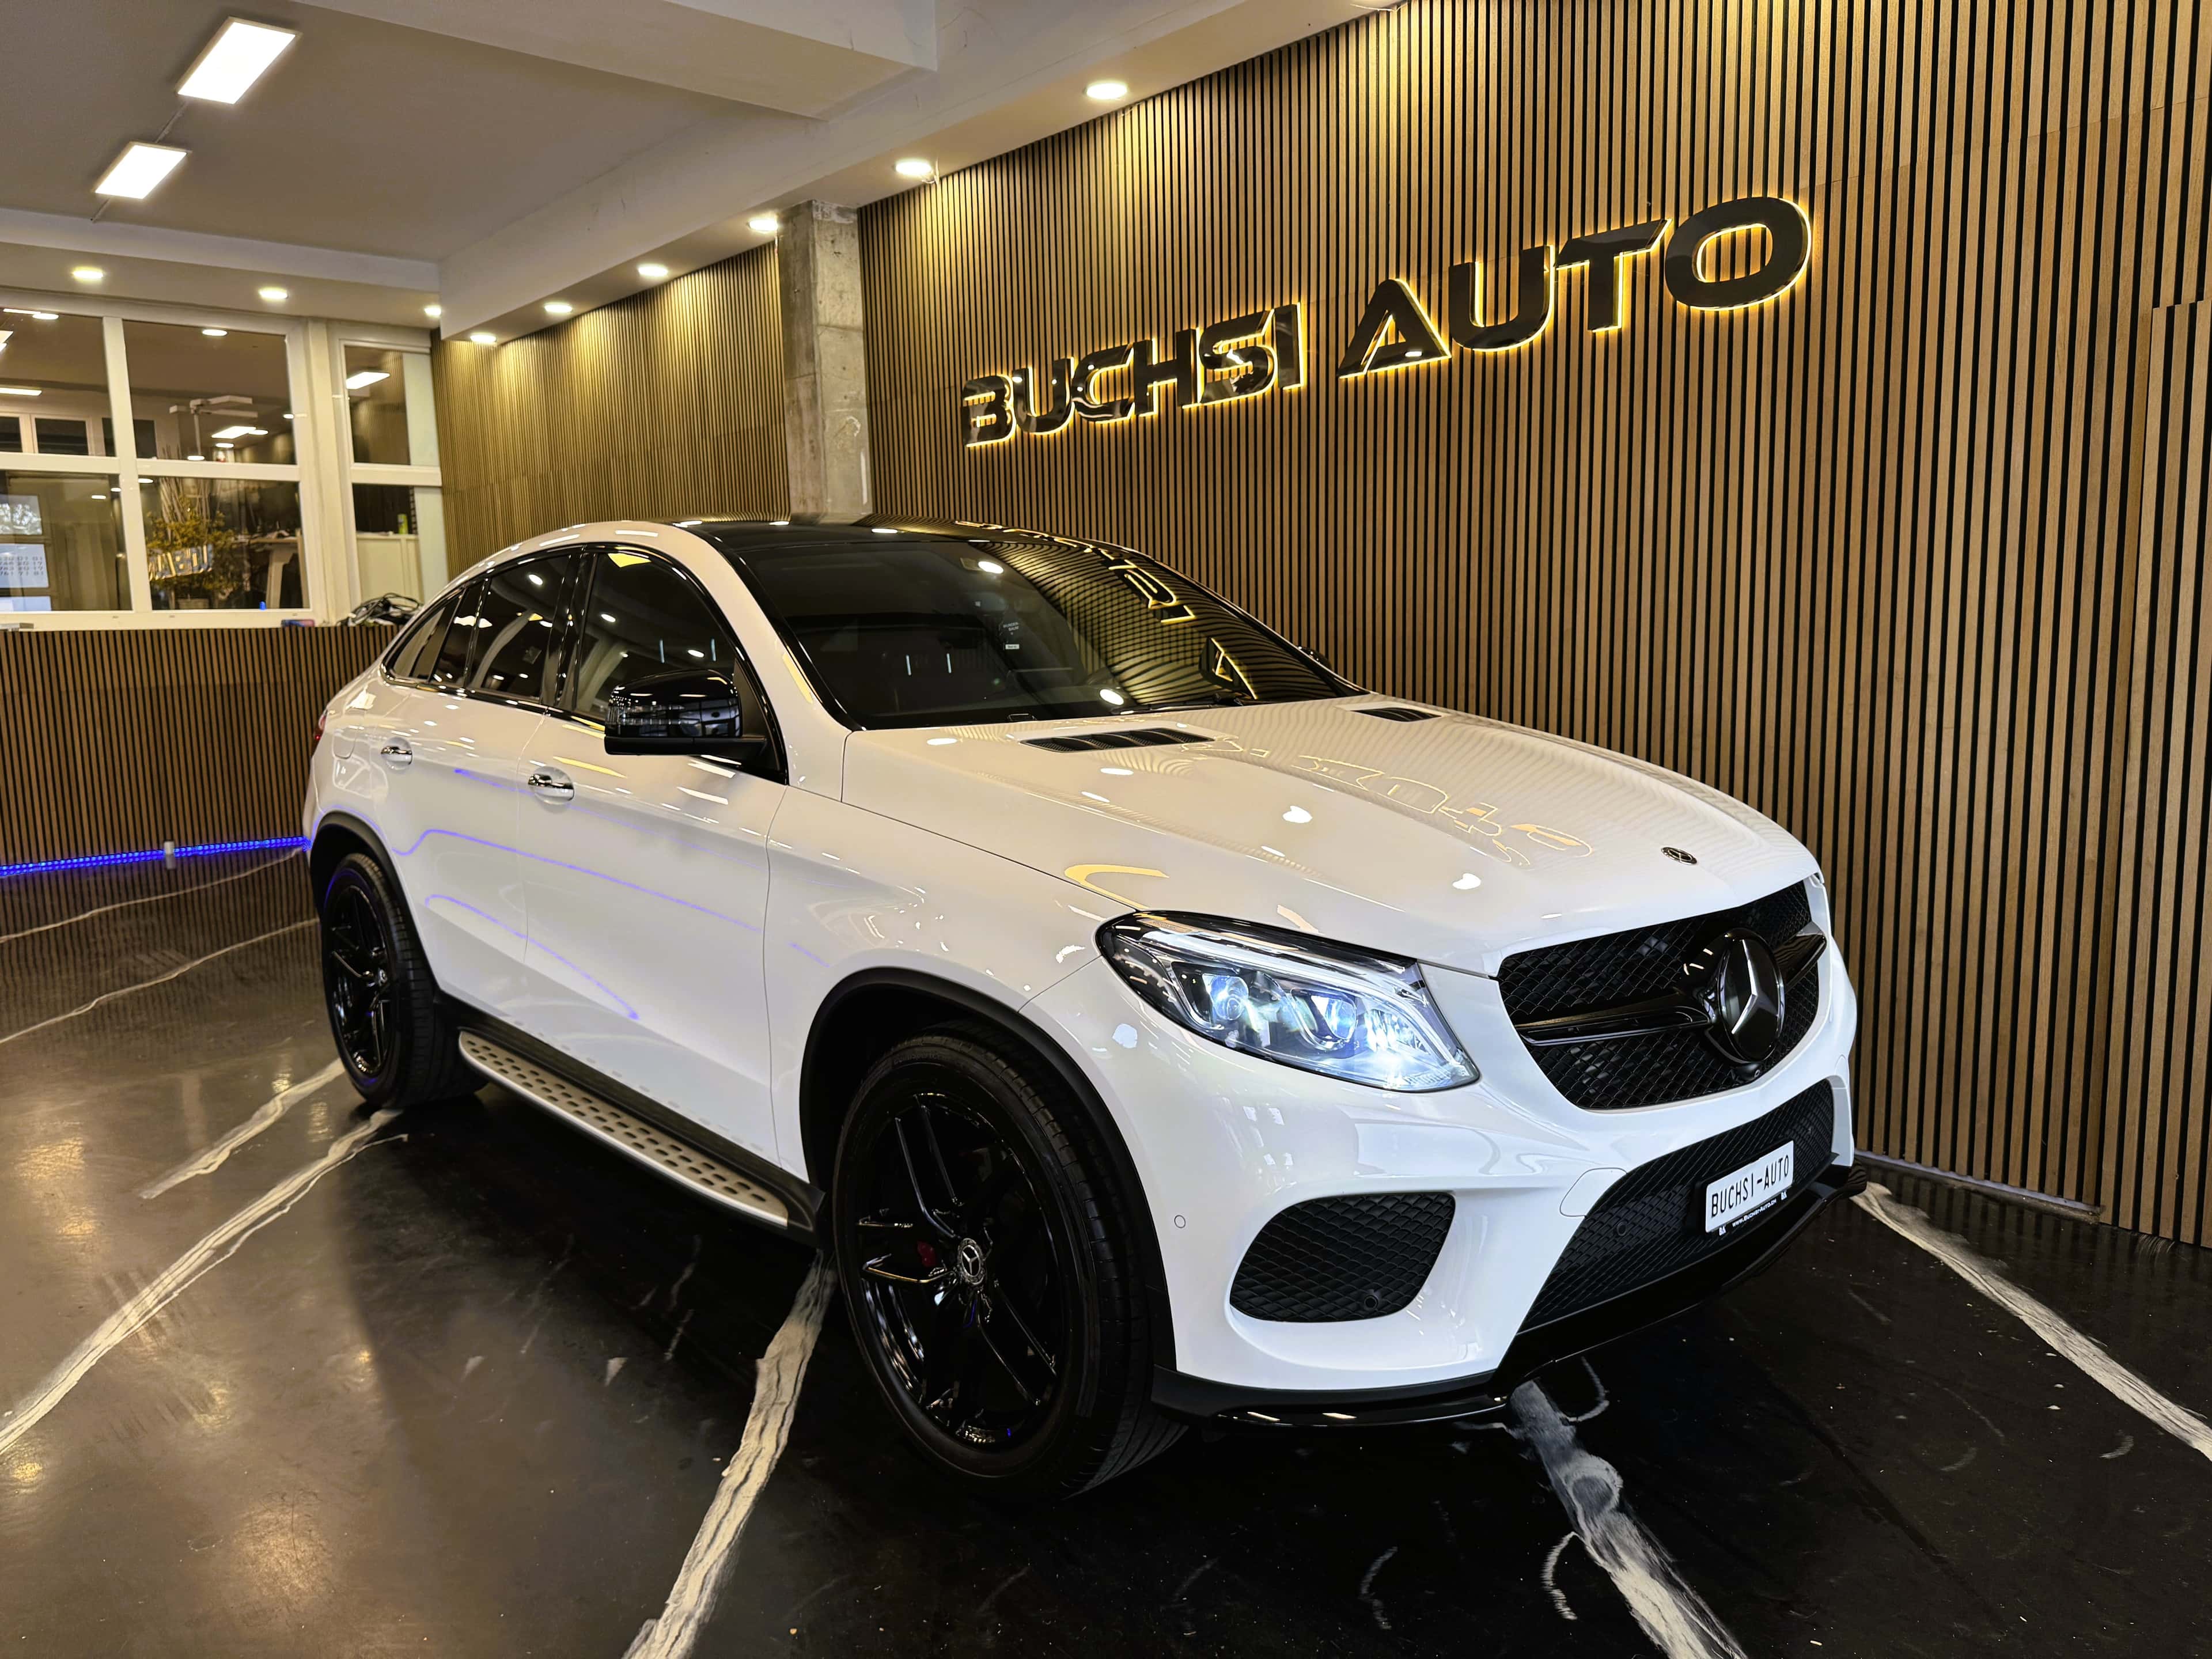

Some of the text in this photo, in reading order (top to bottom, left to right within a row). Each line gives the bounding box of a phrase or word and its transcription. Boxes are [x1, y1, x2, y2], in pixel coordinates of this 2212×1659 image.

[960, 196, 1812, 448] BUCHSI AUTO
[1711, 1154, 1789, 1218] BUCHSI-AUTO
